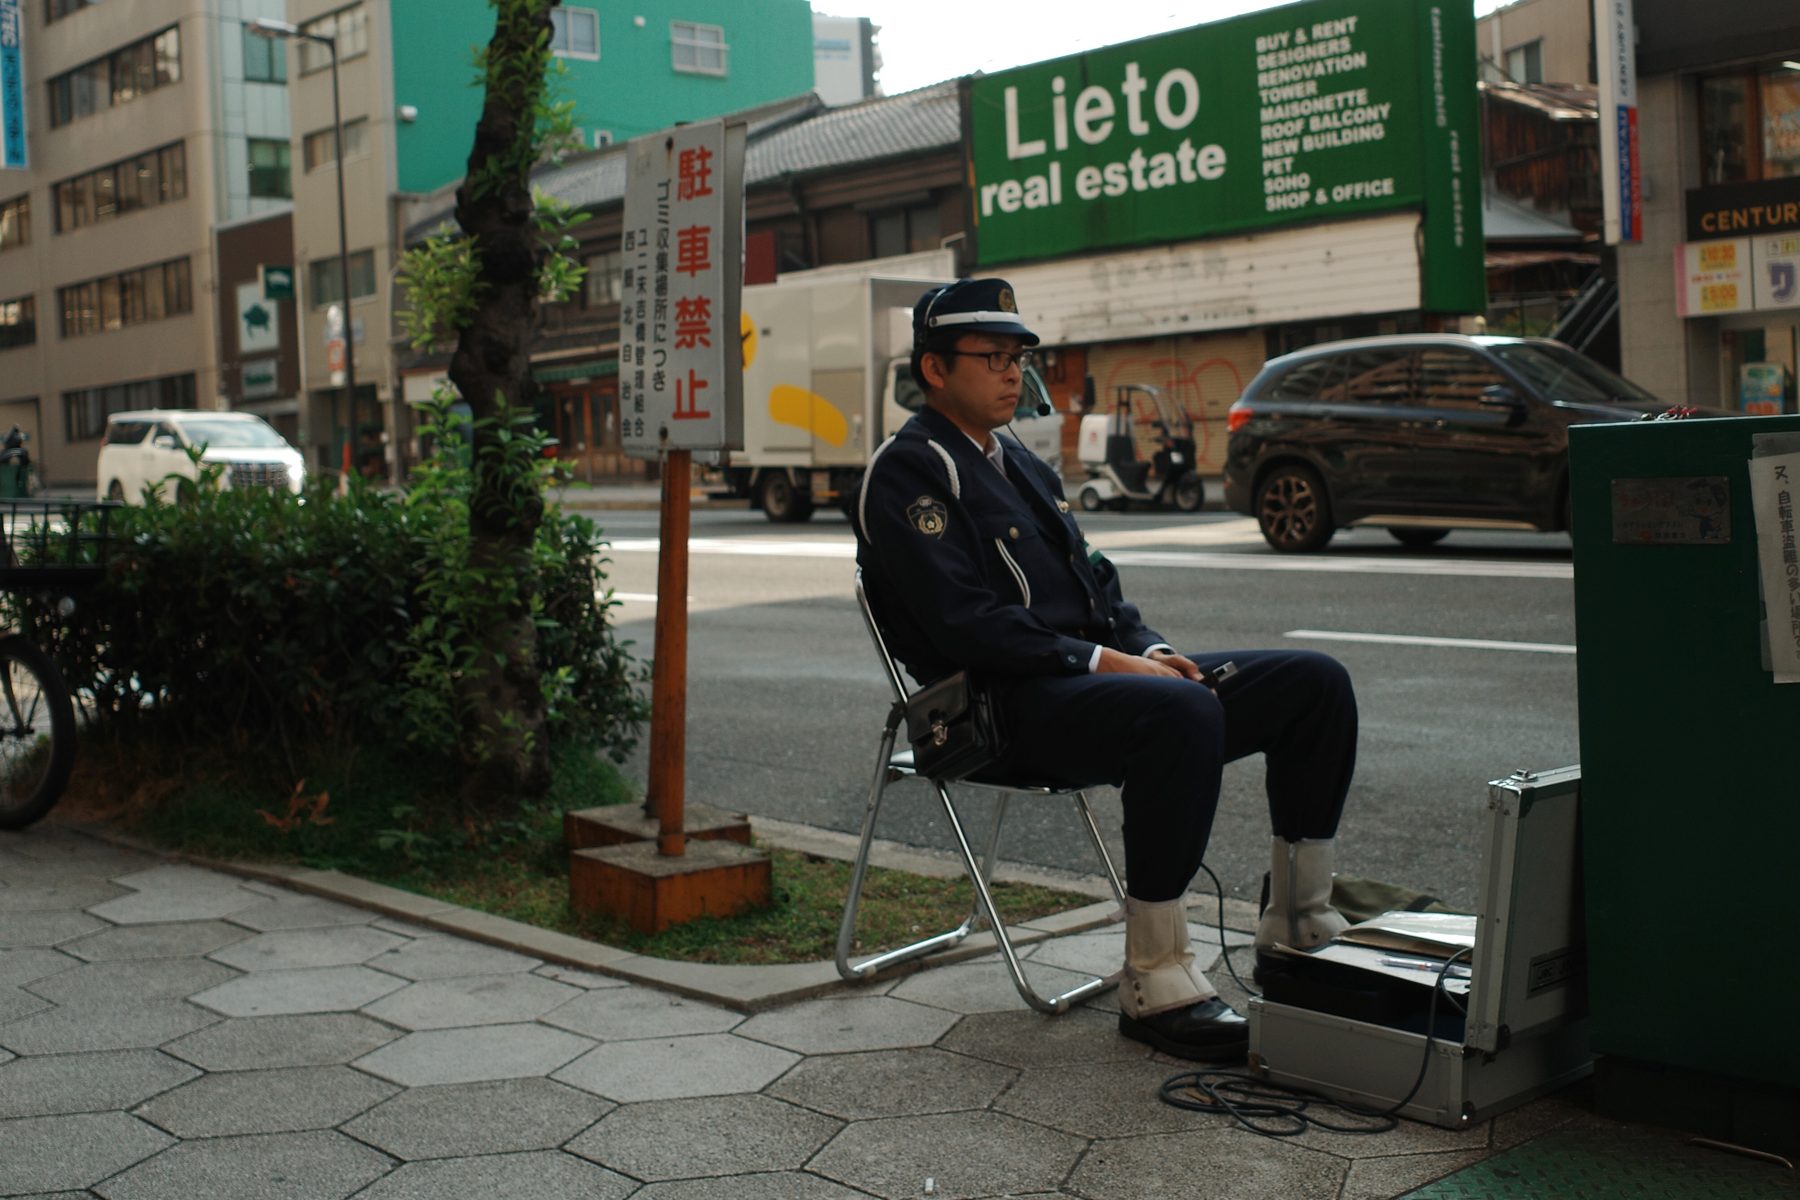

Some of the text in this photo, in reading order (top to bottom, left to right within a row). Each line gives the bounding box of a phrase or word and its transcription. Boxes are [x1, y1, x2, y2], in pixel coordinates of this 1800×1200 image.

[1256, 16, 1358, 53] BUY & RENT
[1257, 36, 1351, 70] DESIGNERS
[1258, 52, 1367, 88] RENOVATION
[1259, 80, 1318, 104] TOWER
[1260, 88, 1368, 123] MAISONETTE
[1005, 62, 1200, 160] Lieto
[1261, 102, 1391, 140] ROOF BALCONY
[1262, 123, 1384, 158] NEW BUILDING
[981, 138, 1227, 217] real estate
[1263, 157, 1294, 176] PET
[1264, 172, 1310, 194] SOHO
[1265, 178, 1394, 211] SHOP & OFFICE
[1700, 203, 1800, 232] CENTUR
[672, 144, 713, 421] 駐車禁止
